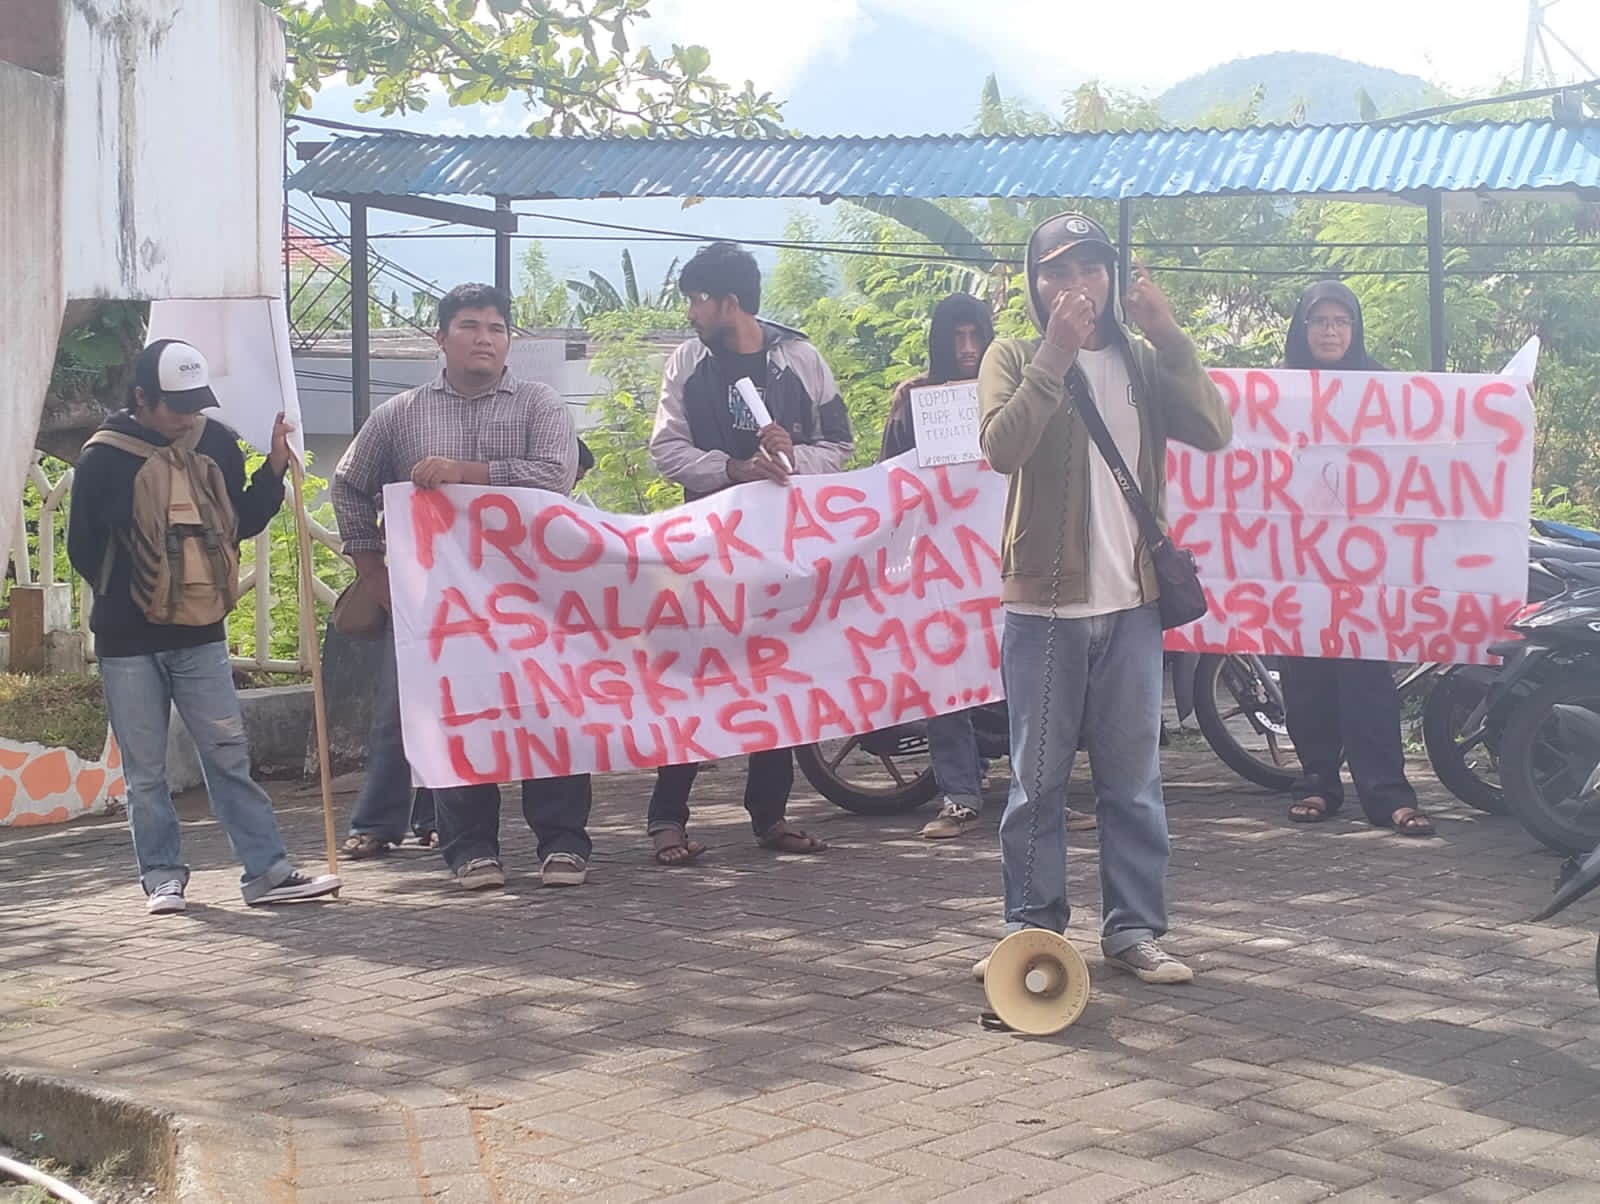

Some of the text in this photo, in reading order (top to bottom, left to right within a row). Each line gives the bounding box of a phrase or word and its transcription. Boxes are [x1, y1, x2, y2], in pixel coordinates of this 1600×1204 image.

[1347, 448, 1507, 520] DAN
[411, 489, 765, 583] PROYEK
[790, 524, 1001, 633] JALAN
[440, 636, 812, 726] LINGKAR
[448, 716, 718, 784] UNTUK
